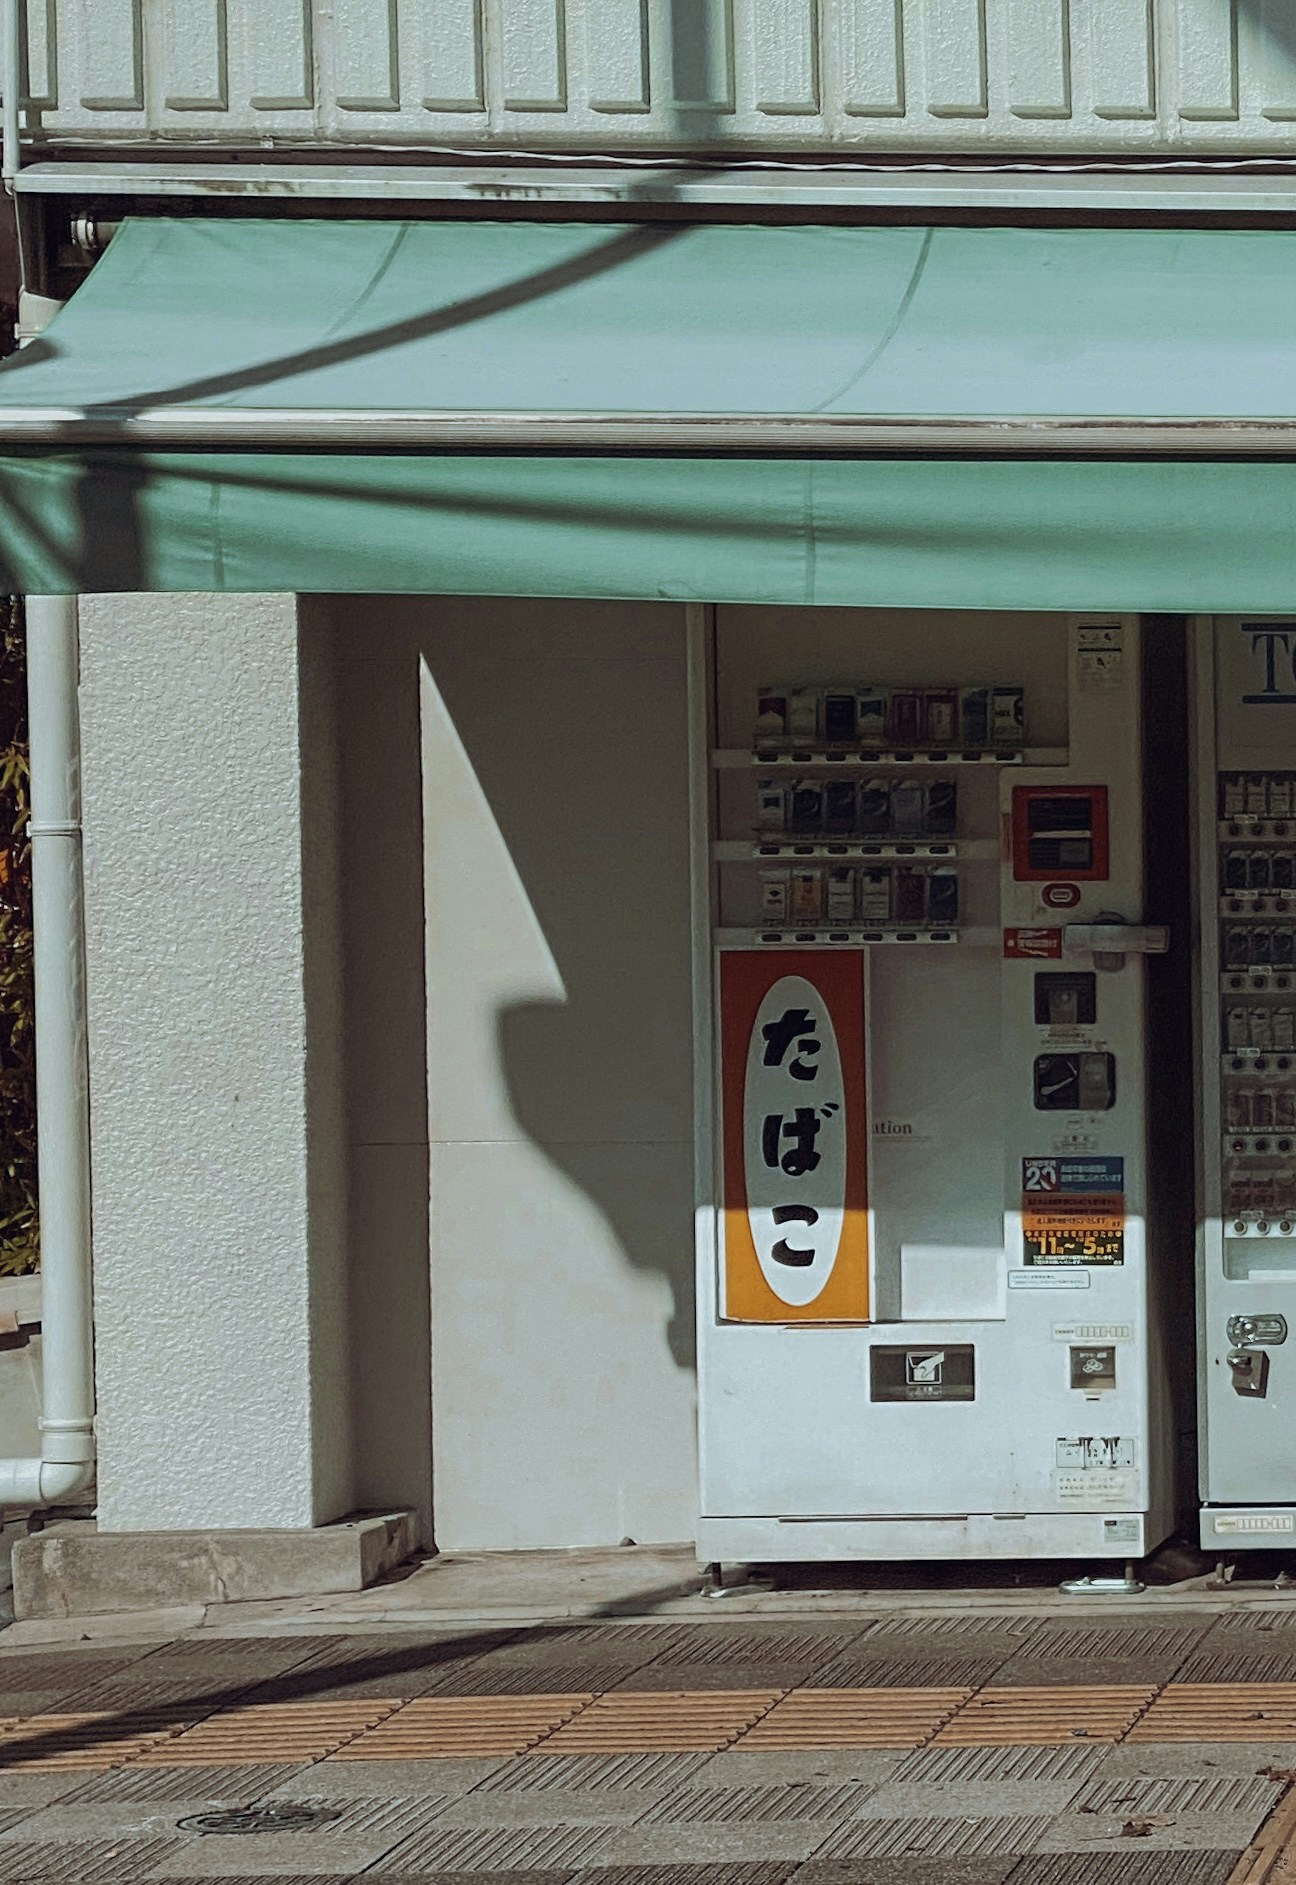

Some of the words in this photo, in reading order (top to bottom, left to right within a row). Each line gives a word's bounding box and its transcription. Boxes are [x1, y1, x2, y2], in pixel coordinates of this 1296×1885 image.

[762, 1008, 840, 1267] たばこ
[1025, 1167, 1057, 1191] 20
